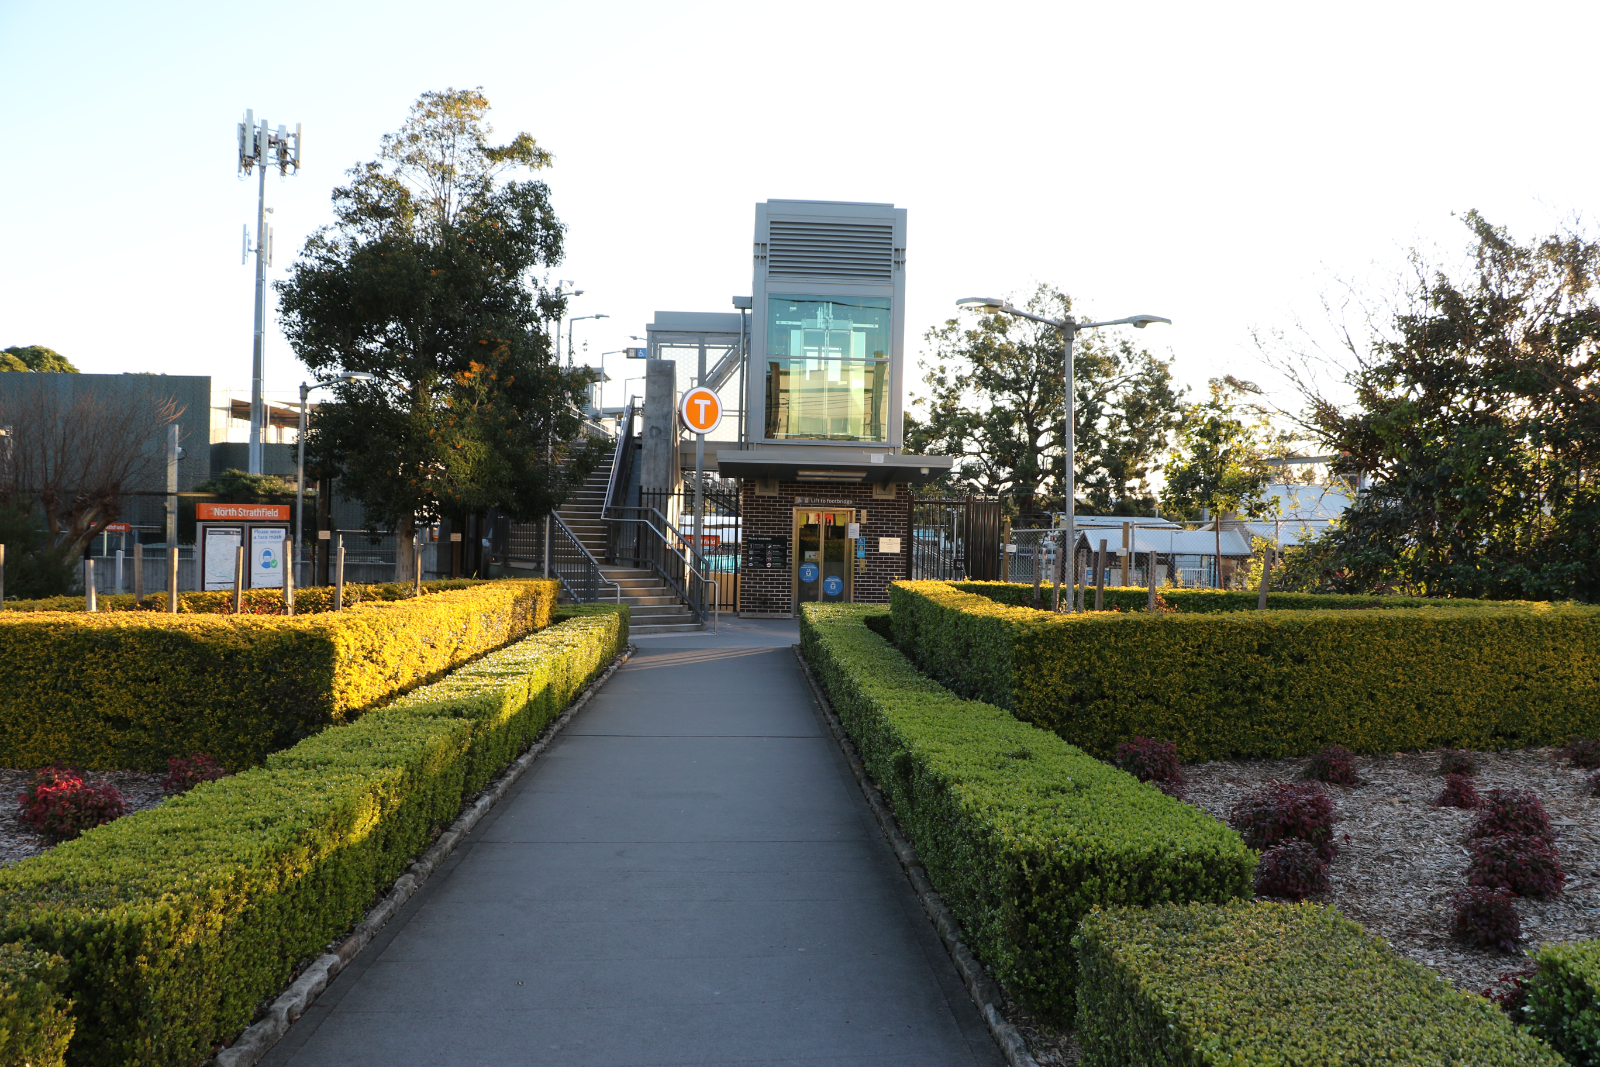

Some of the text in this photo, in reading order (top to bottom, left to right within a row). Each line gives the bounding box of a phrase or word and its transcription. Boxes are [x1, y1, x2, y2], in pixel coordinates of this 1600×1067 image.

[694, 399, 711, 424] T
[214, 507, 279, 517] North Strathfield
